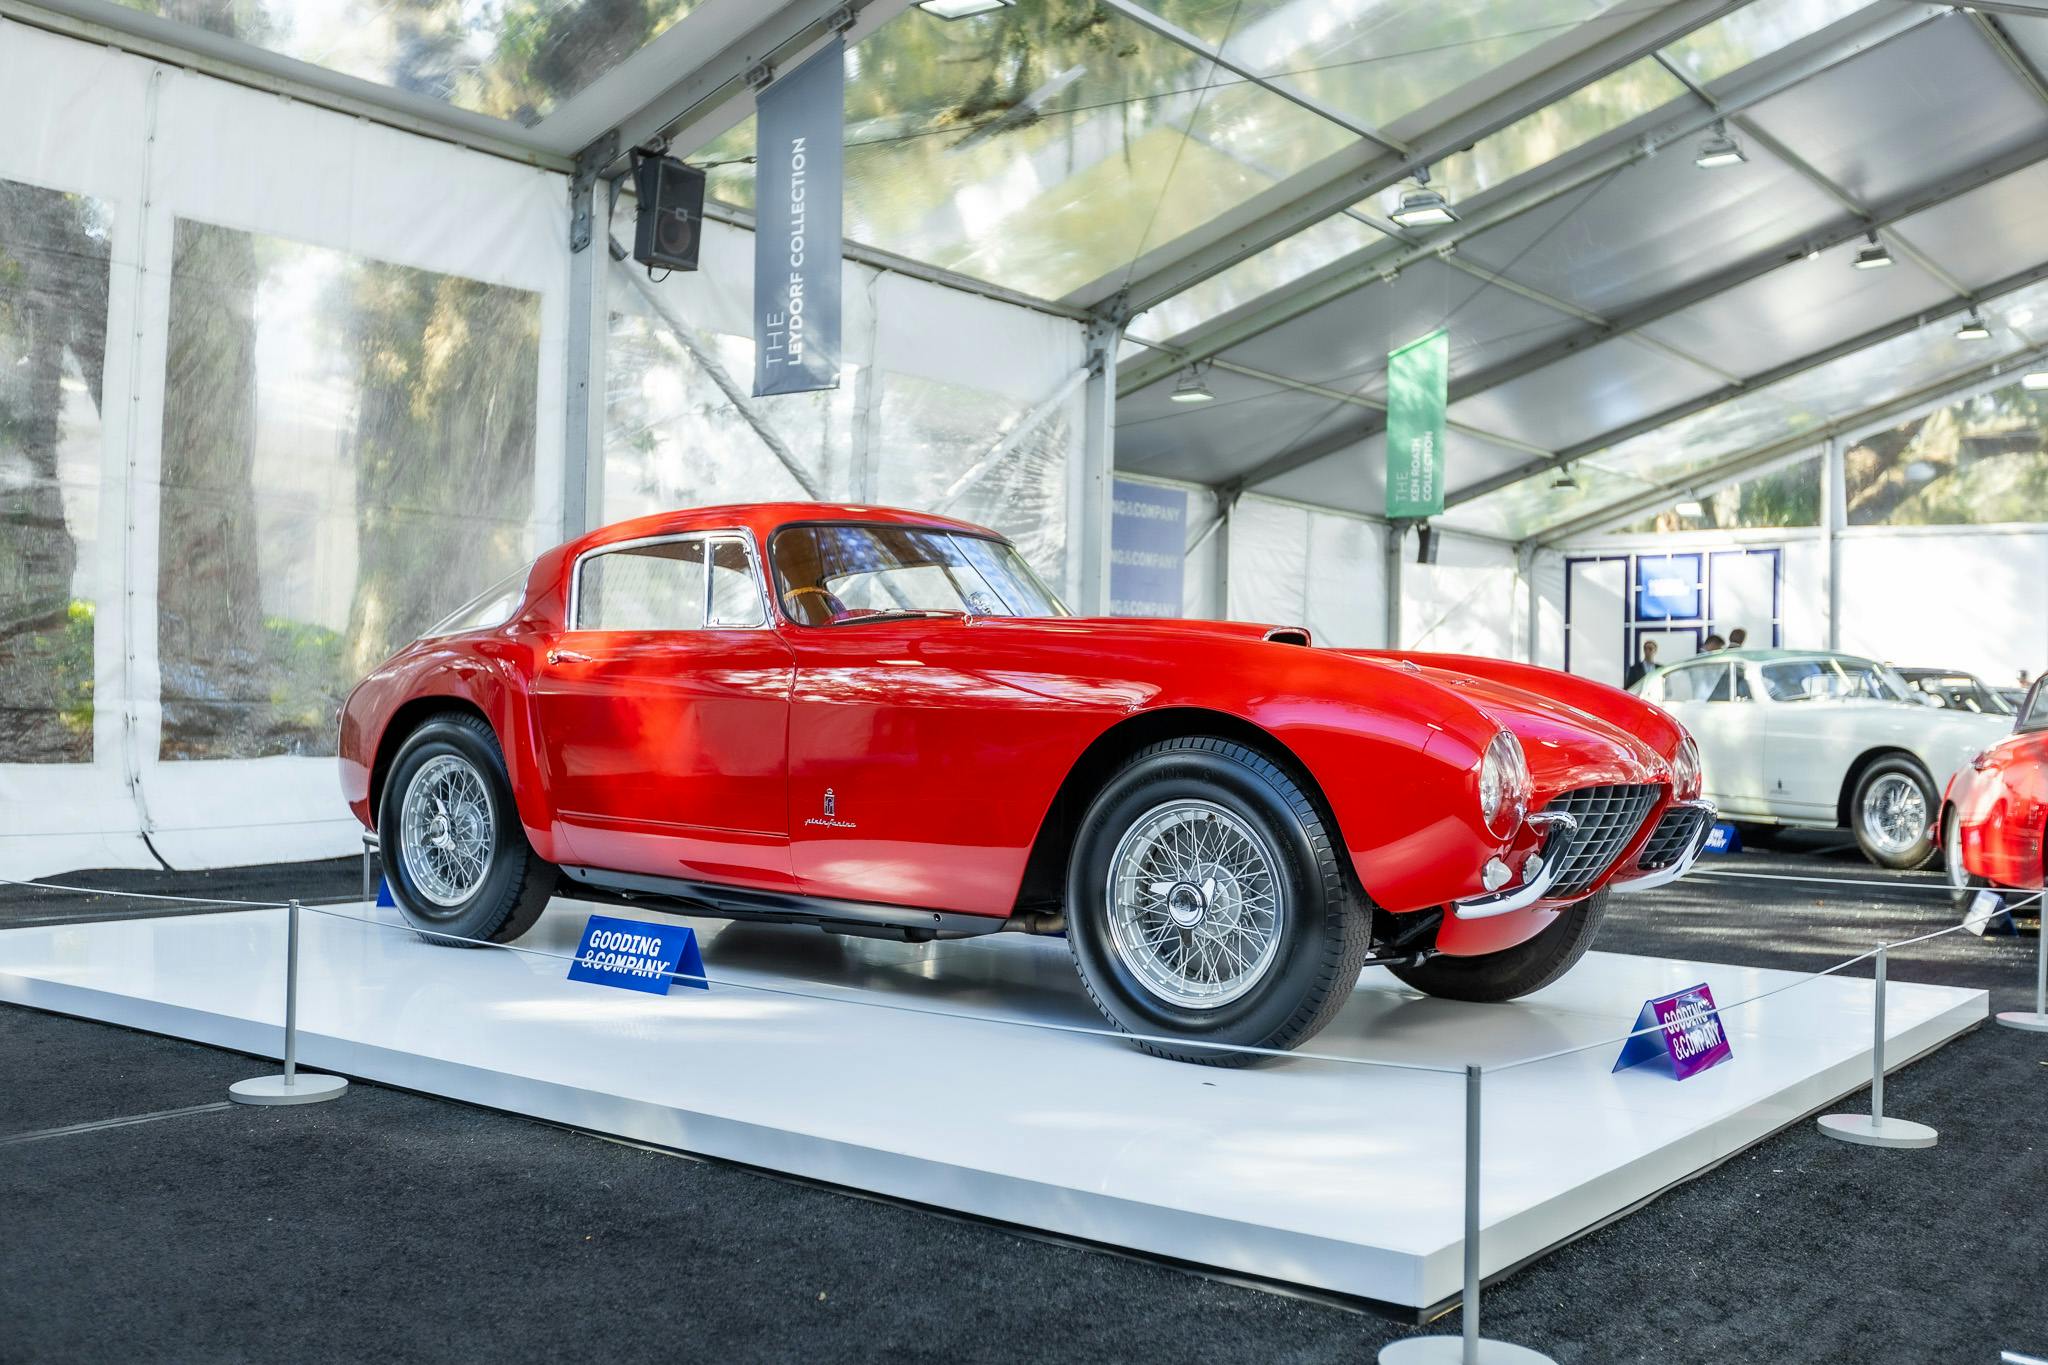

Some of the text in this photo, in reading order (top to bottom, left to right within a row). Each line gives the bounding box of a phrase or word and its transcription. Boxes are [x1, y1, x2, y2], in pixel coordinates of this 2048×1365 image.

[788, 137, 806, 366] LEYDORF COLLECTION
[766, 311, 785, 369] THE
[1423, 431, 1433, 502] COLLECTION
[1396, 472, 1408, 504] THE
[1411, 479, 1421, 502] KEN
[589, 929, 662, 957] GOODING
[581, 949, 668, 980] &COMPANY
[1663, 1000, 1710, 1035] GOODING
[1672, 1020, 1723, 1060] &COMPANY
